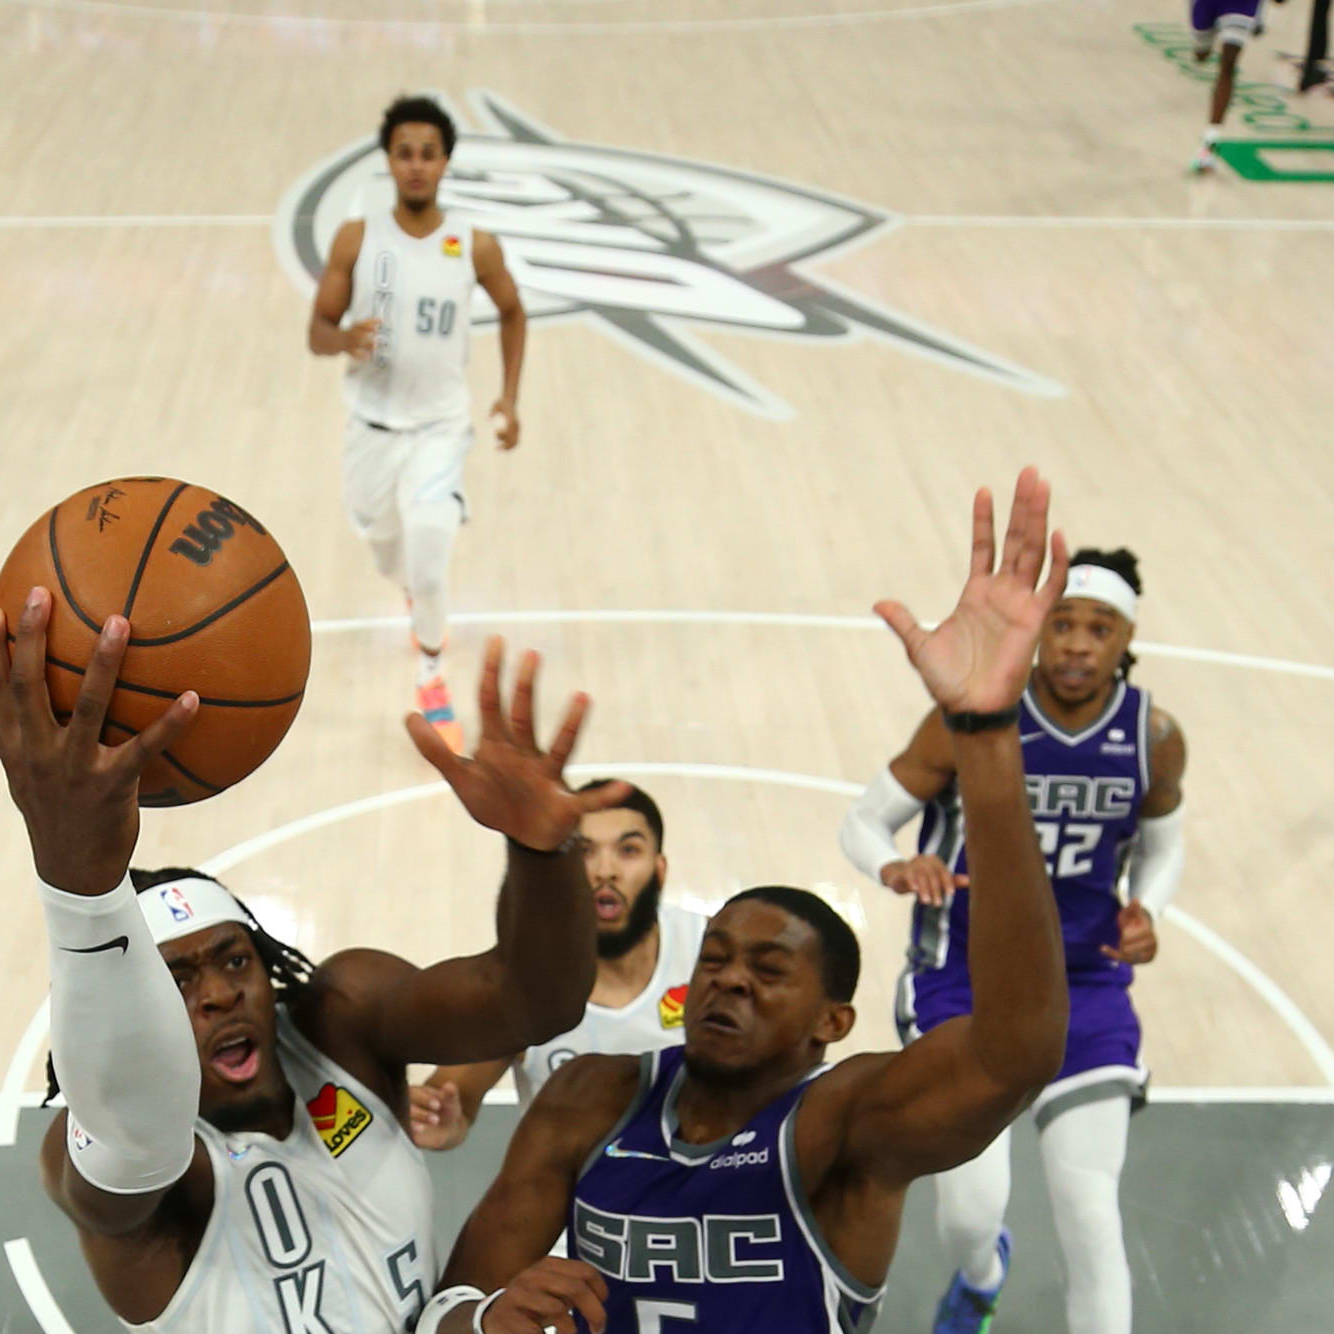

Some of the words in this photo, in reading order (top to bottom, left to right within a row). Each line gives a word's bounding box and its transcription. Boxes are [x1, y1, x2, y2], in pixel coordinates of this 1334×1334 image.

[416, 296, 457, 338] 50
[710, 1147, 769, 1169] dialpad
[574, 1197, 785, 1284] SAC
[386, 1239, 424, 1334] 5
